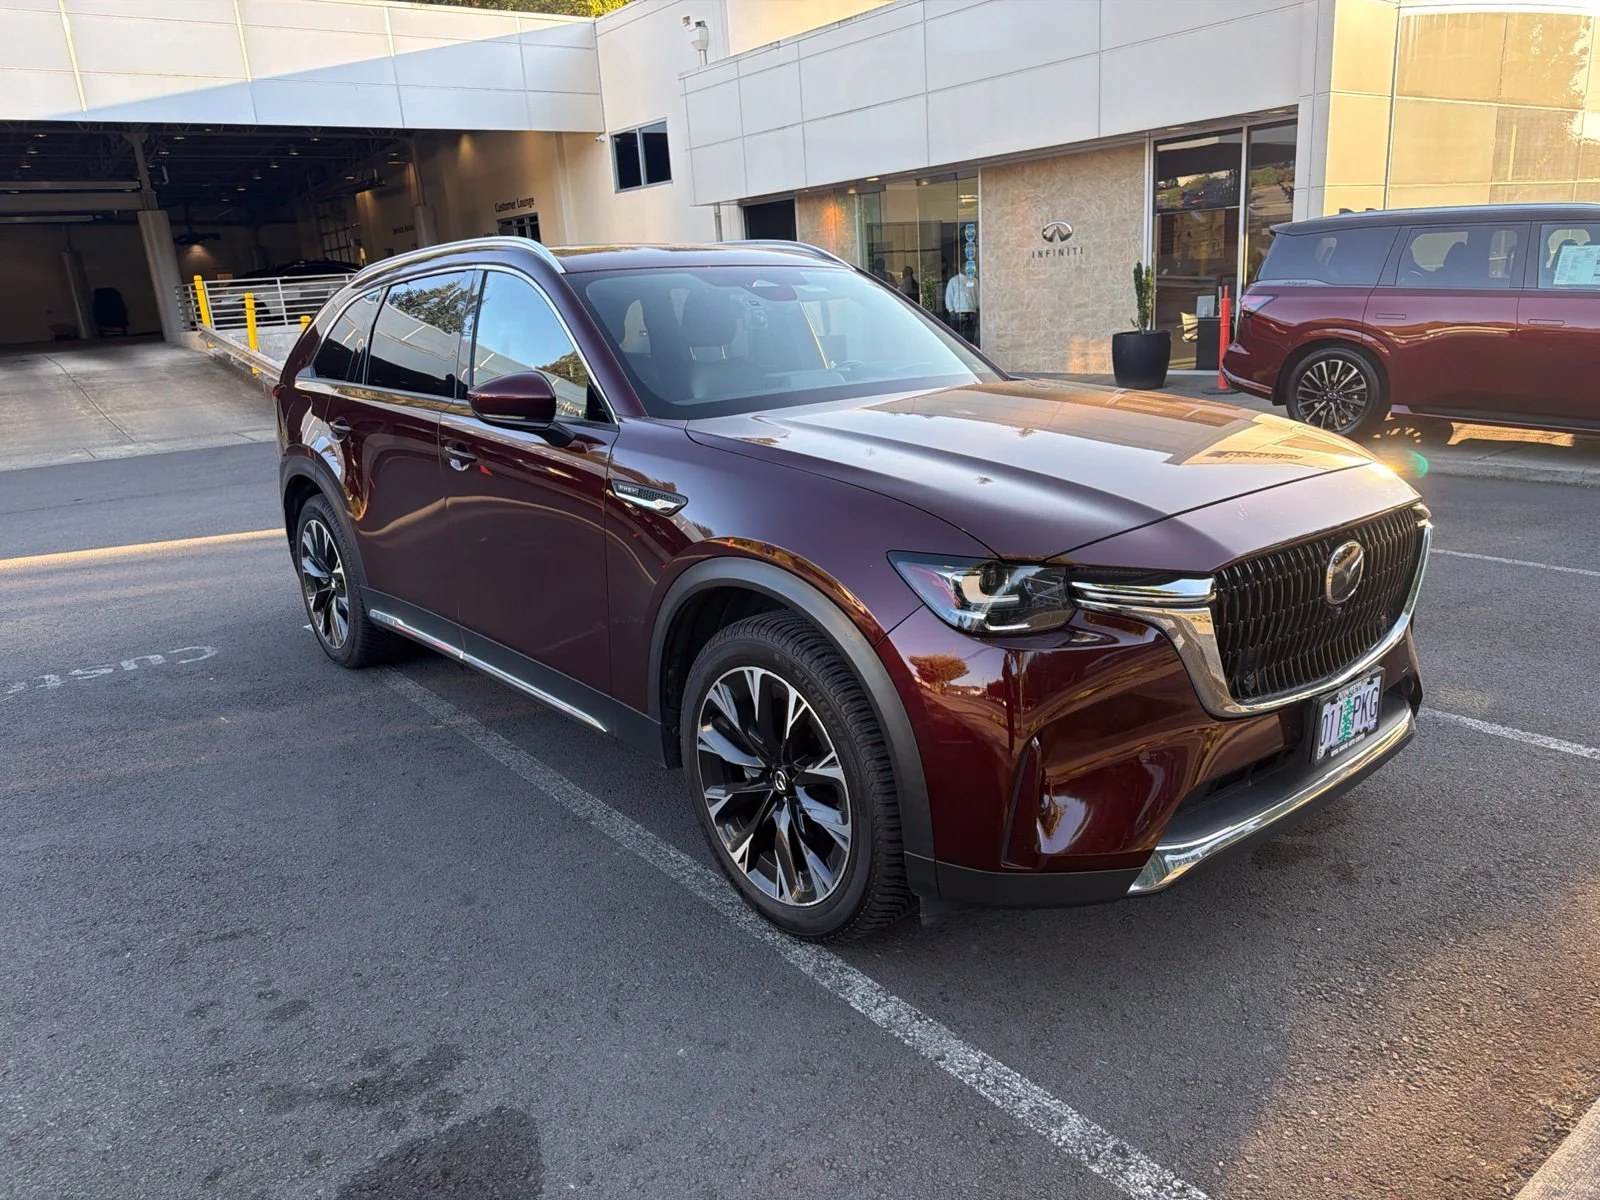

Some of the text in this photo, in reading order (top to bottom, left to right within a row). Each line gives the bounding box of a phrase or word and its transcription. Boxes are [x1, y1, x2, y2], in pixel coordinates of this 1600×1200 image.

[495, 197, 535, 213] Customer Lounge
[1032, 247, 1083, 259] INFINITI
